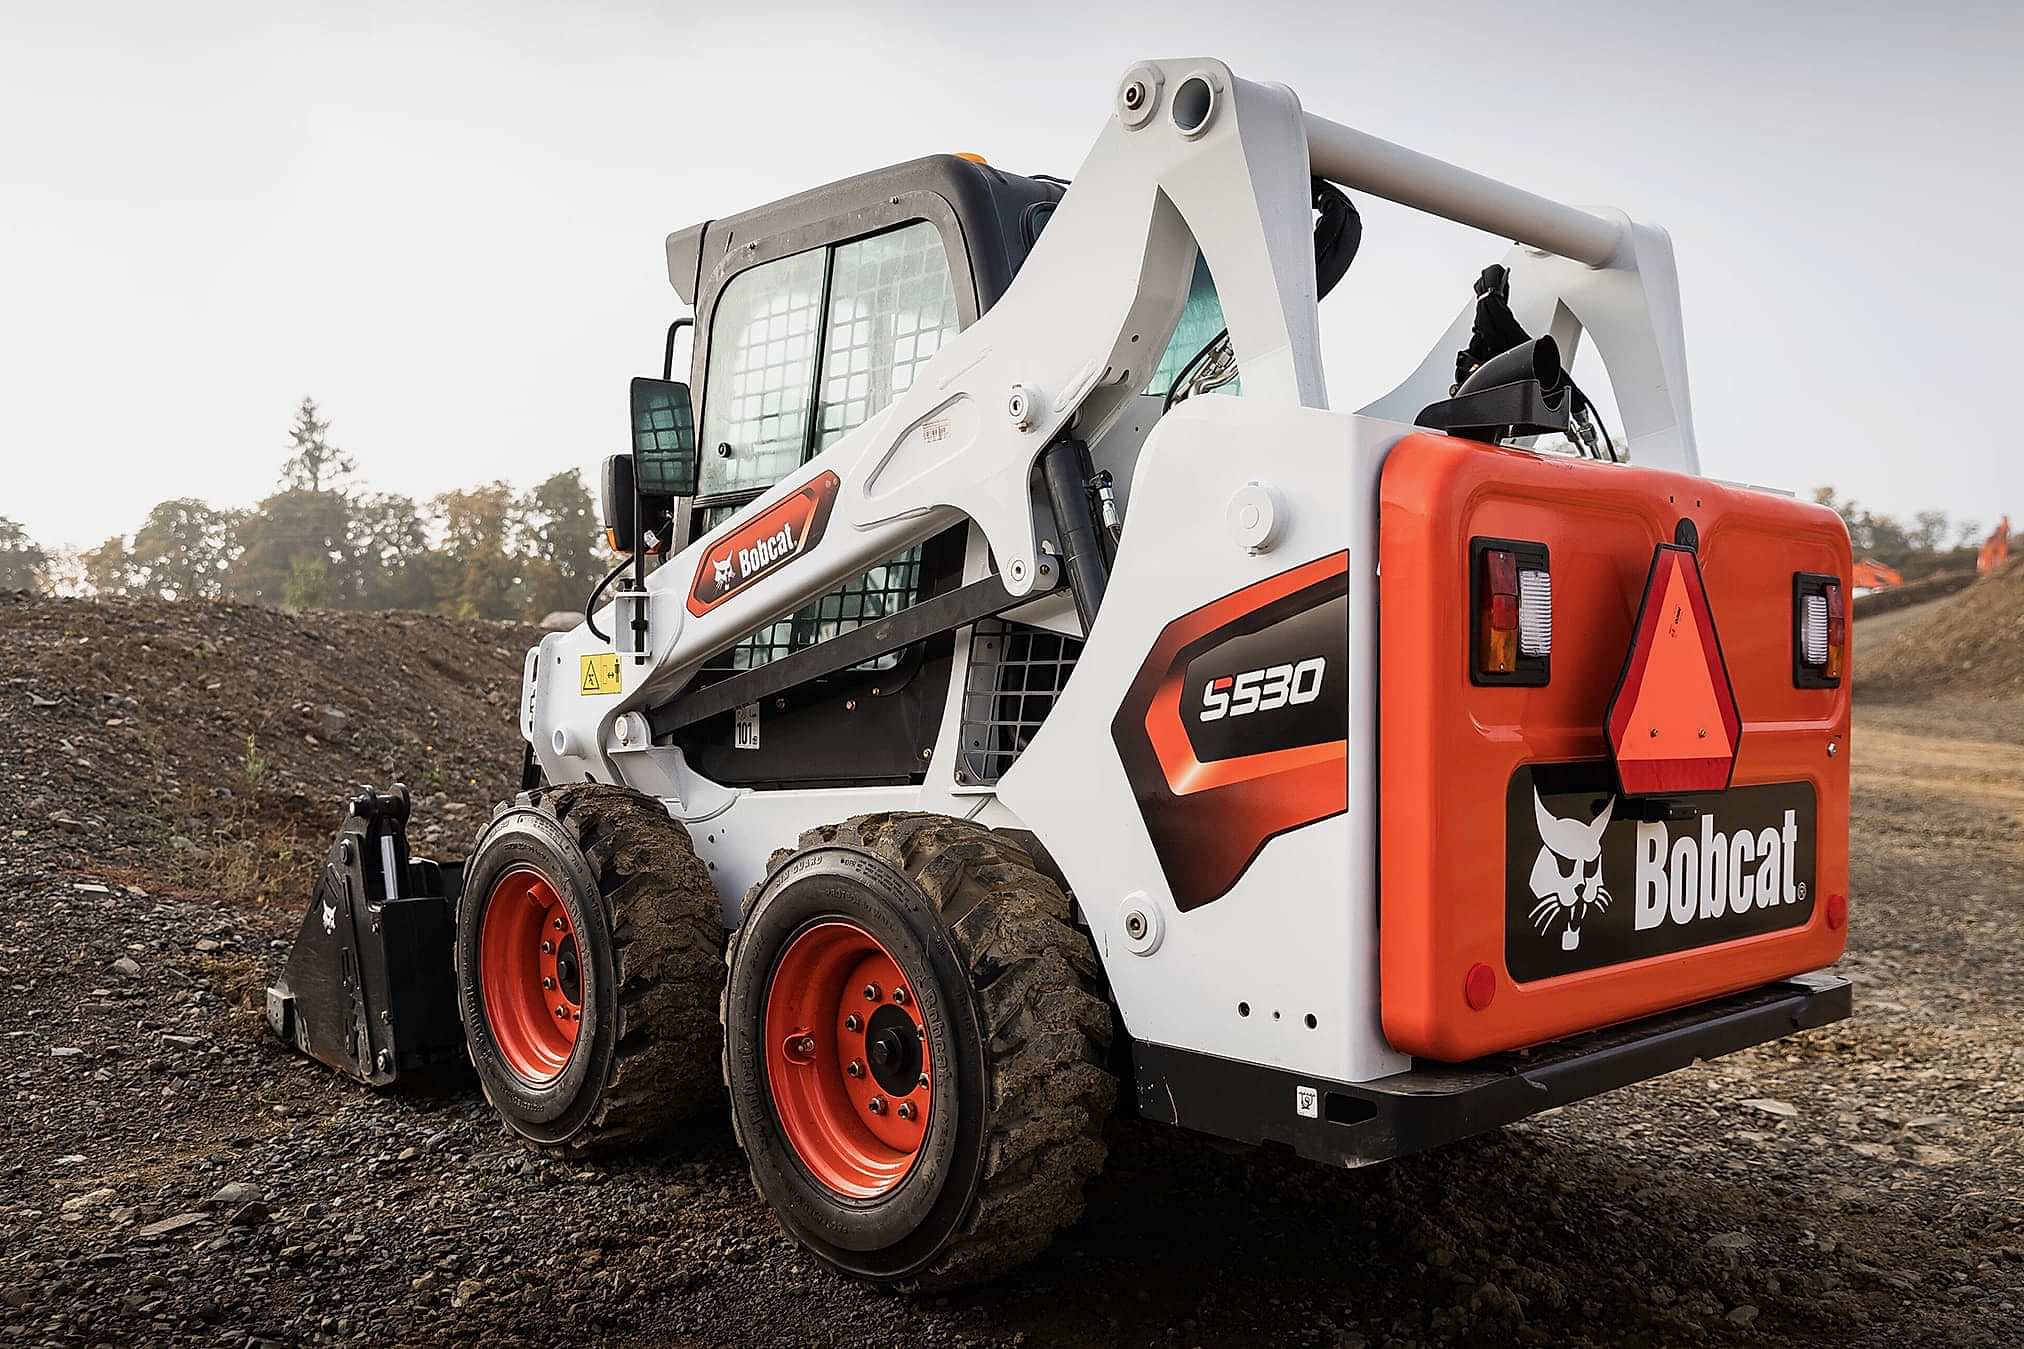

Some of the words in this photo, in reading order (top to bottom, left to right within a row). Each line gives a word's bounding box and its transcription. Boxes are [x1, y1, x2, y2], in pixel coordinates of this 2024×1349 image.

[738, 522, 793, 578] Bobcat
[1199, 657, 1327, 722] S530
[737, 722, 752, 744] 101
[793, 855, 823, 874] GUARD
[1634, 809, 1797, 930] Bobcat
